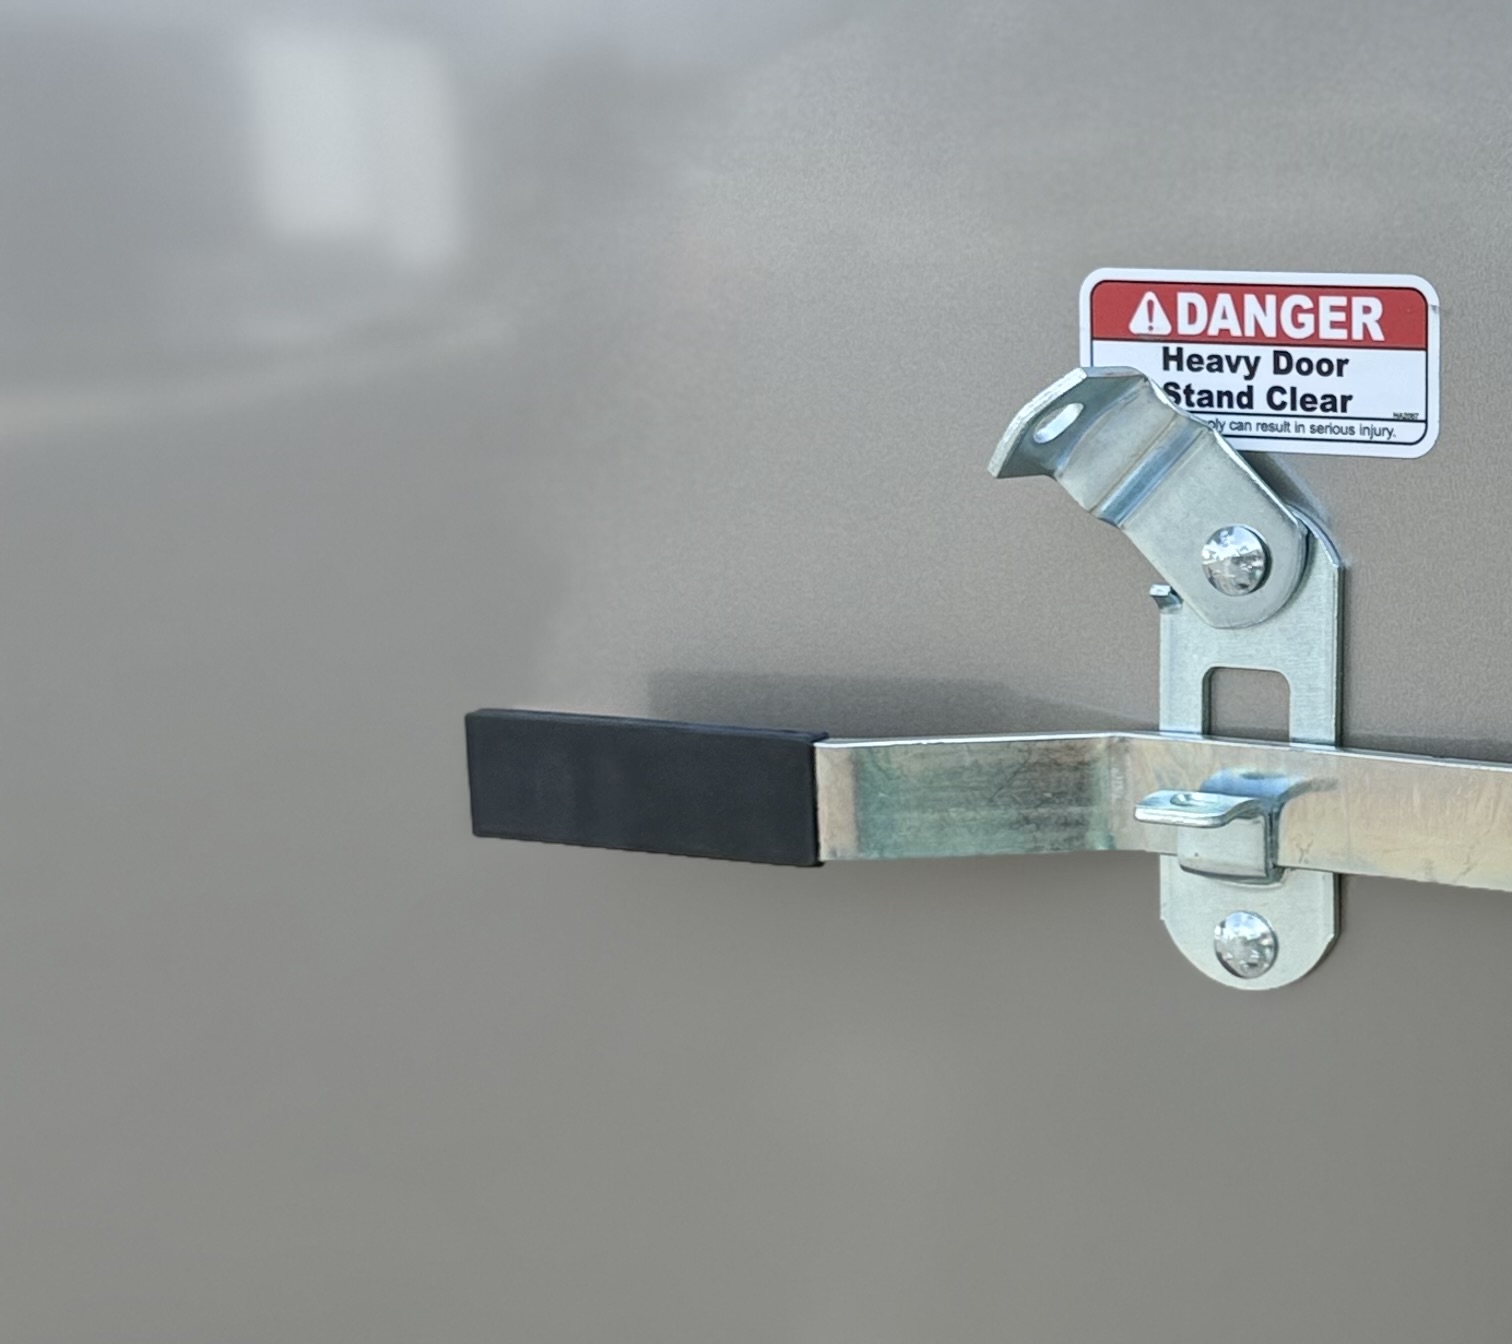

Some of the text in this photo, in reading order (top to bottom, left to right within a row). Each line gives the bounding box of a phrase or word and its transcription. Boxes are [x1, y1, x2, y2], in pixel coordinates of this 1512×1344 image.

[1176, 292, 1385, 342] DANGER
[1162, 346, 1350, 380] Heavy Door
[1163, 381, 1354, 413] Stand Clear
[1229, 421, 1252, 432] can
[1255, 419, 1291, 434] result
[1294, 422, 1305, 434] in
[1309, 423, 1356, 437] serious
[1359, 424, 1397, 440] injury.
